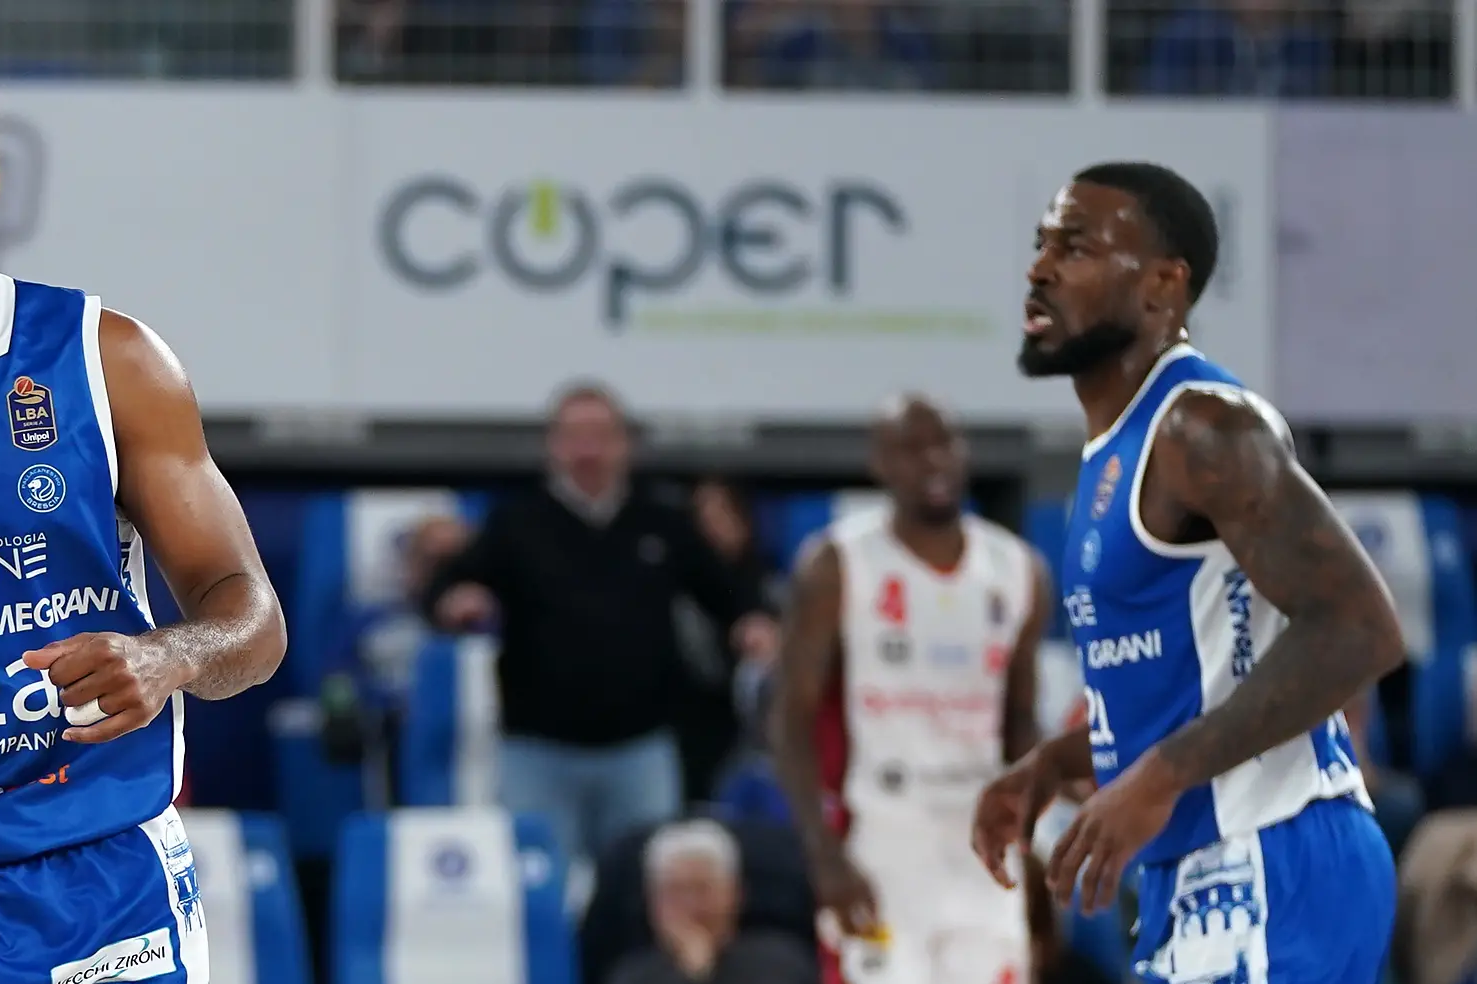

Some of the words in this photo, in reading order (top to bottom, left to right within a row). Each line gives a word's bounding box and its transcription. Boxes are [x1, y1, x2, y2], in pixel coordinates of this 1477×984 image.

[15, 406, 49, 421] LBA
[22, 431, 50, 443] Unipol
[26, 496, 60, 510] BRESCIA
[114, 945, 166, 970] ZIRONI
